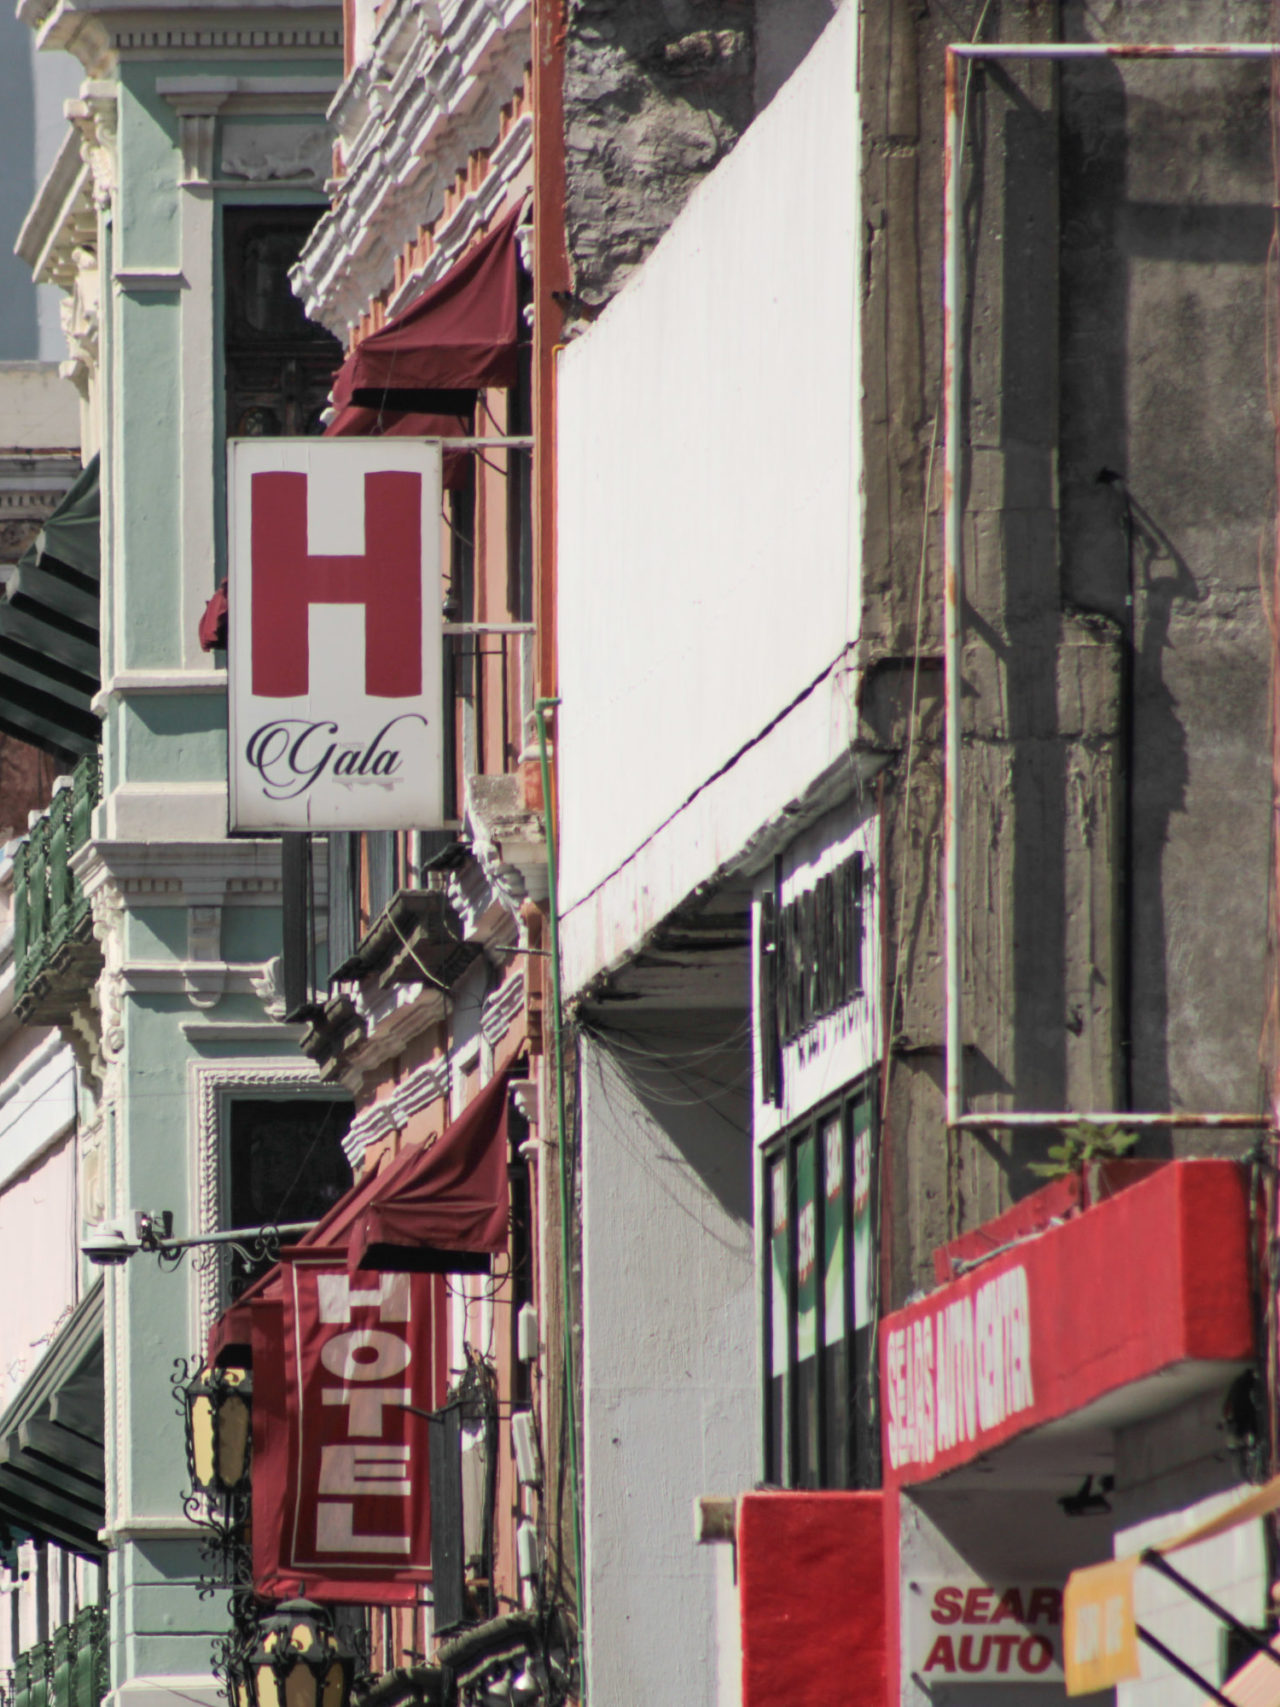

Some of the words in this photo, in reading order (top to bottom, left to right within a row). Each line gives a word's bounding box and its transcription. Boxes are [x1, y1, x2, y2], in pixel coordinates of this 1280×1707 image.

[251, 471, 422, 698] H
[246, 714, 428, 800] Gala
[316, 1273, 412, 1554] HOTEL
[887, 1315, 935, 1470] SEARS
[923, 1635, 1054, 1674] AUTO
